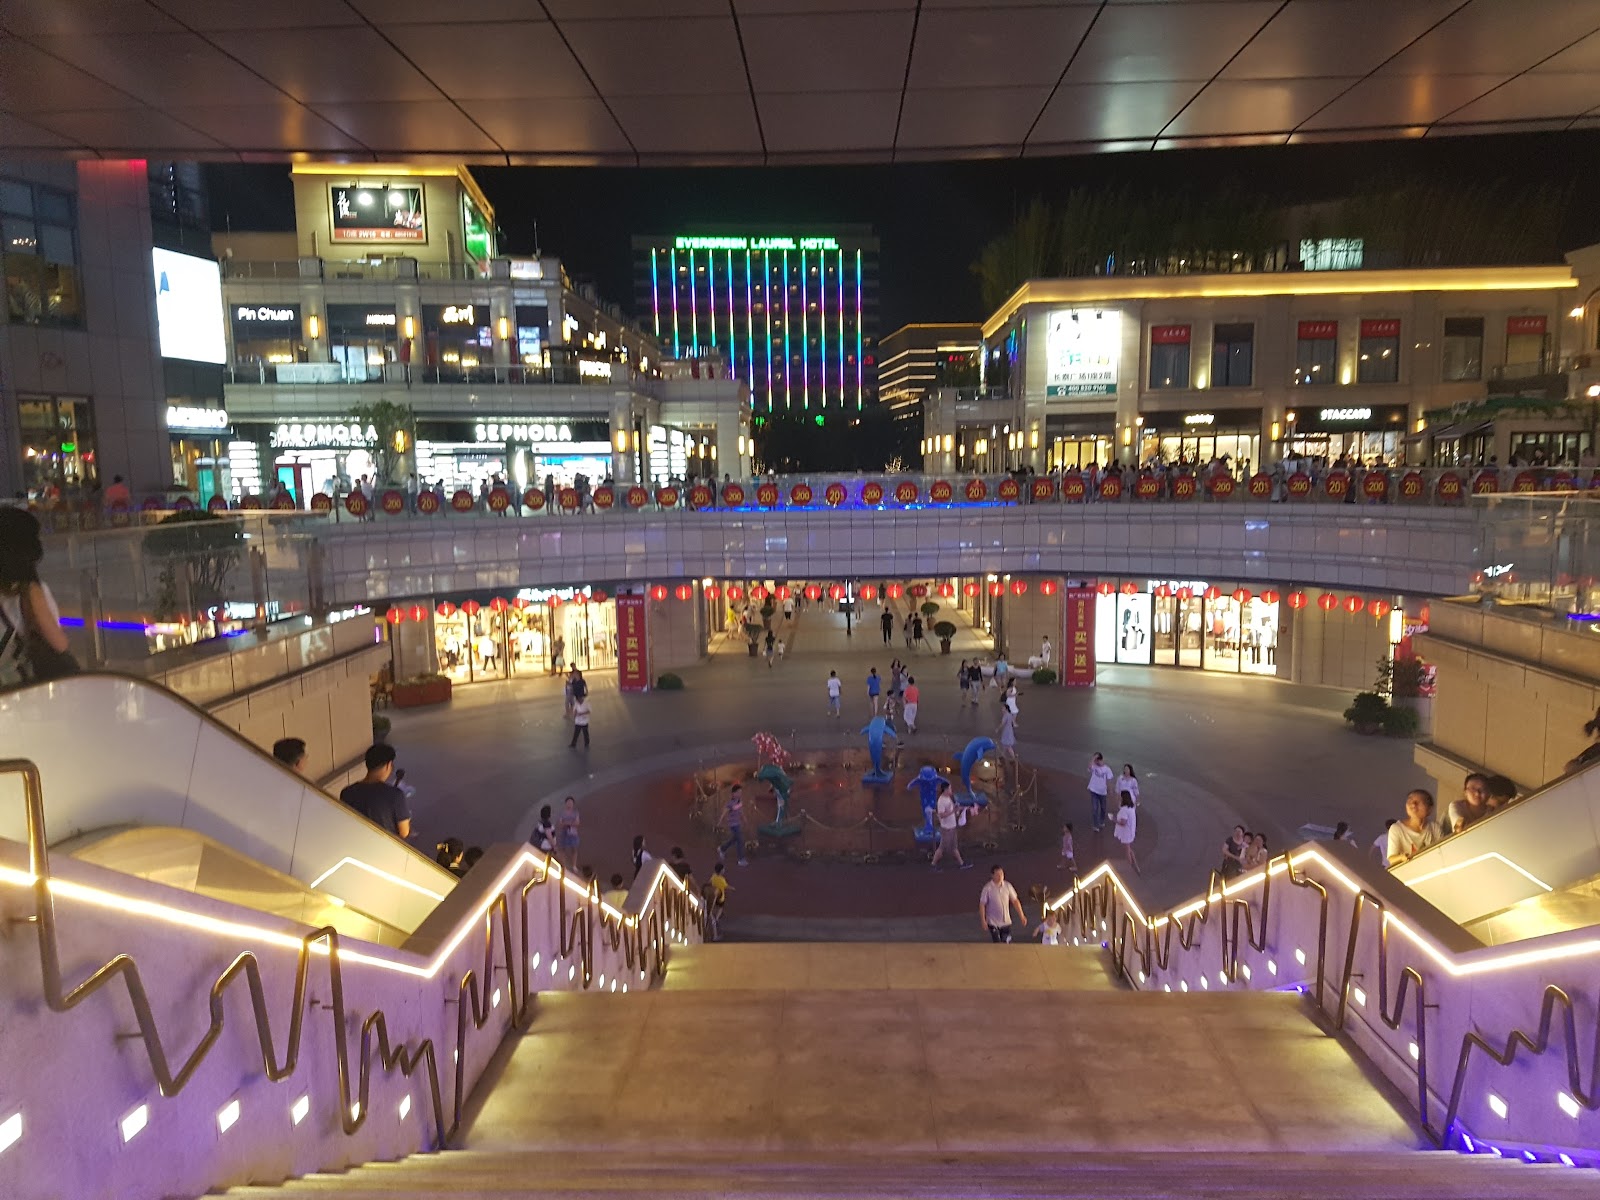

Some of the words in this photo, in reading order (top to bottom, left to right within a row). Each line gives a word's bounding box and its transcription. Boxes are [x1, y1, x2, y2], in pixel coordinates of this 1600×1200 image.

[675, 237, 747, 249] EVERGREEN
[750, 237, 797, 250] LAUREL
[799, 237, 839, 250] HOTEL
[238, 307, 256, 321] Pin
[257, 307, 294, 321] Chuan
[1320, 408, 1372, 421] STACCATO
[475, 424, 572, 442] SEPHORA
[626, 636, 640, 680] 买一送一
[1073, 630, 1088, 674] 买一送一
